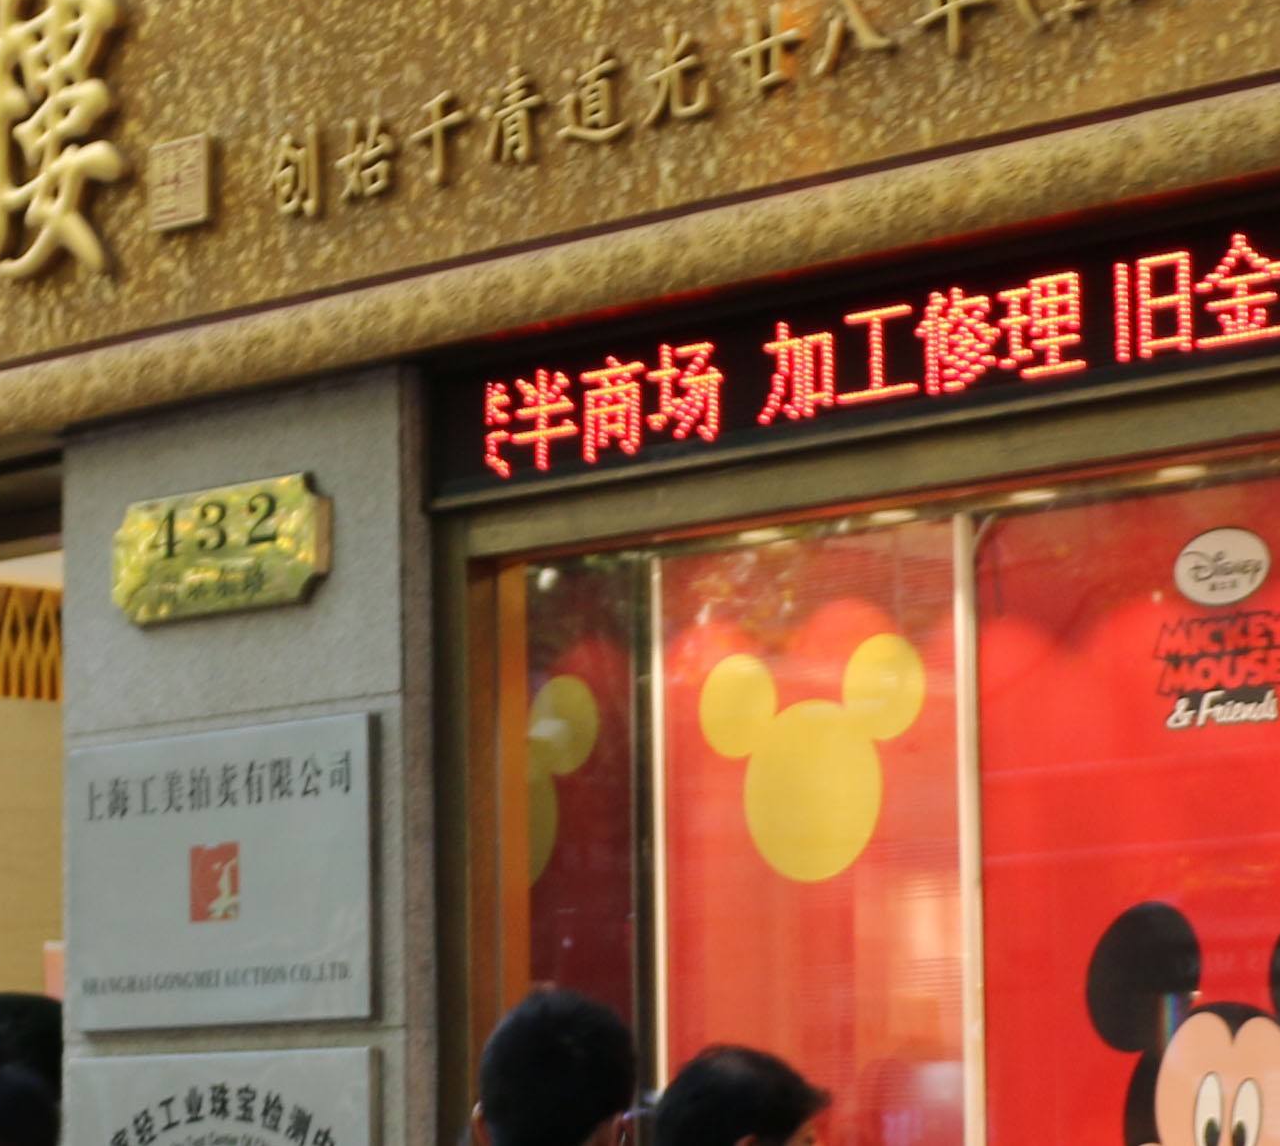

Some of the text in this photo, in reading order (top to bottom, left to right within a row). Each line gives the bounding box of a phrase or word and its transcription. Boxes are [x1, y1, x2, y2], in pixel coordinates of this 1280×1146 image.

[758, 268, 1088, 427] 加工修理
[149, 492, 278, 559] 432
[1165, 687, 1280, 730] & Friends
[85, 749, 353, 822] 上海工美拍卖有限公司
